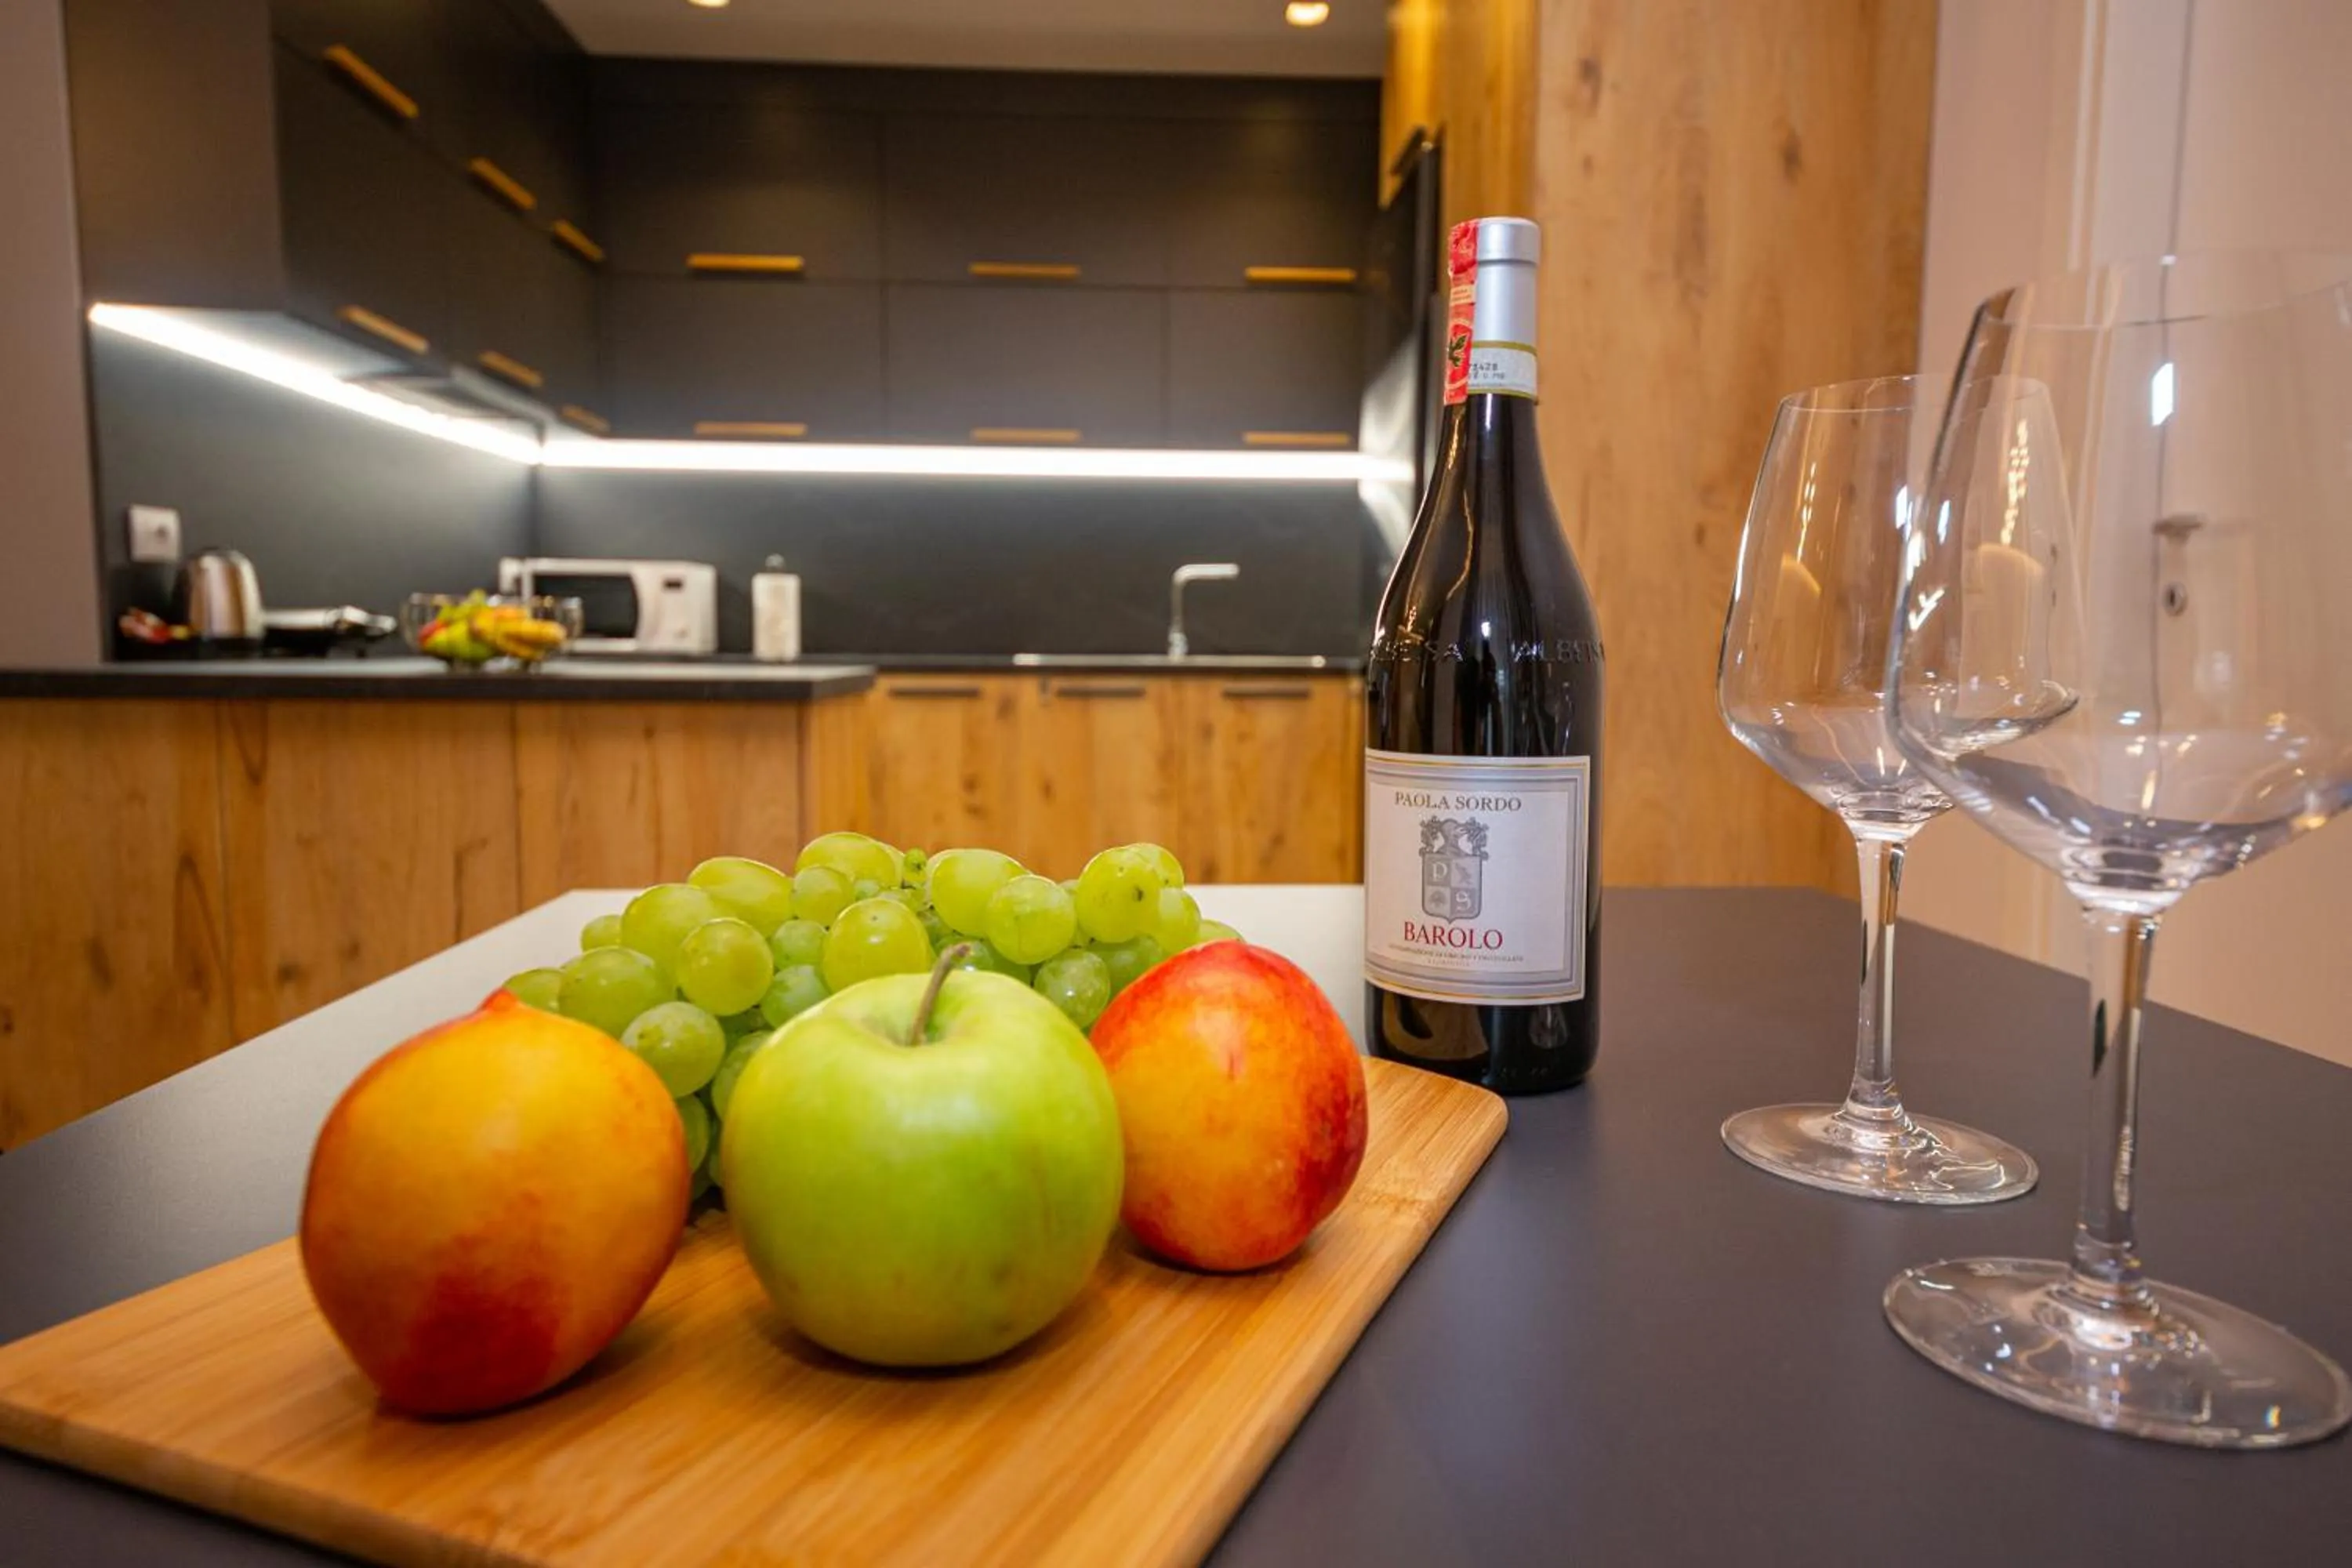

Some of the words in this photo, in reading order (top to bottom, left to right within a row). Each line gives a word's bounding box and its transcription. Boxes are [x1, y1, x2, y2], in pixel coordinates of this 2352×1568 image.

[1394, 791, 1450, 811] PAOLA
[1454, 795, 1522, 812] SORDO
[1403, 921, 1503, 950] BAROLO
